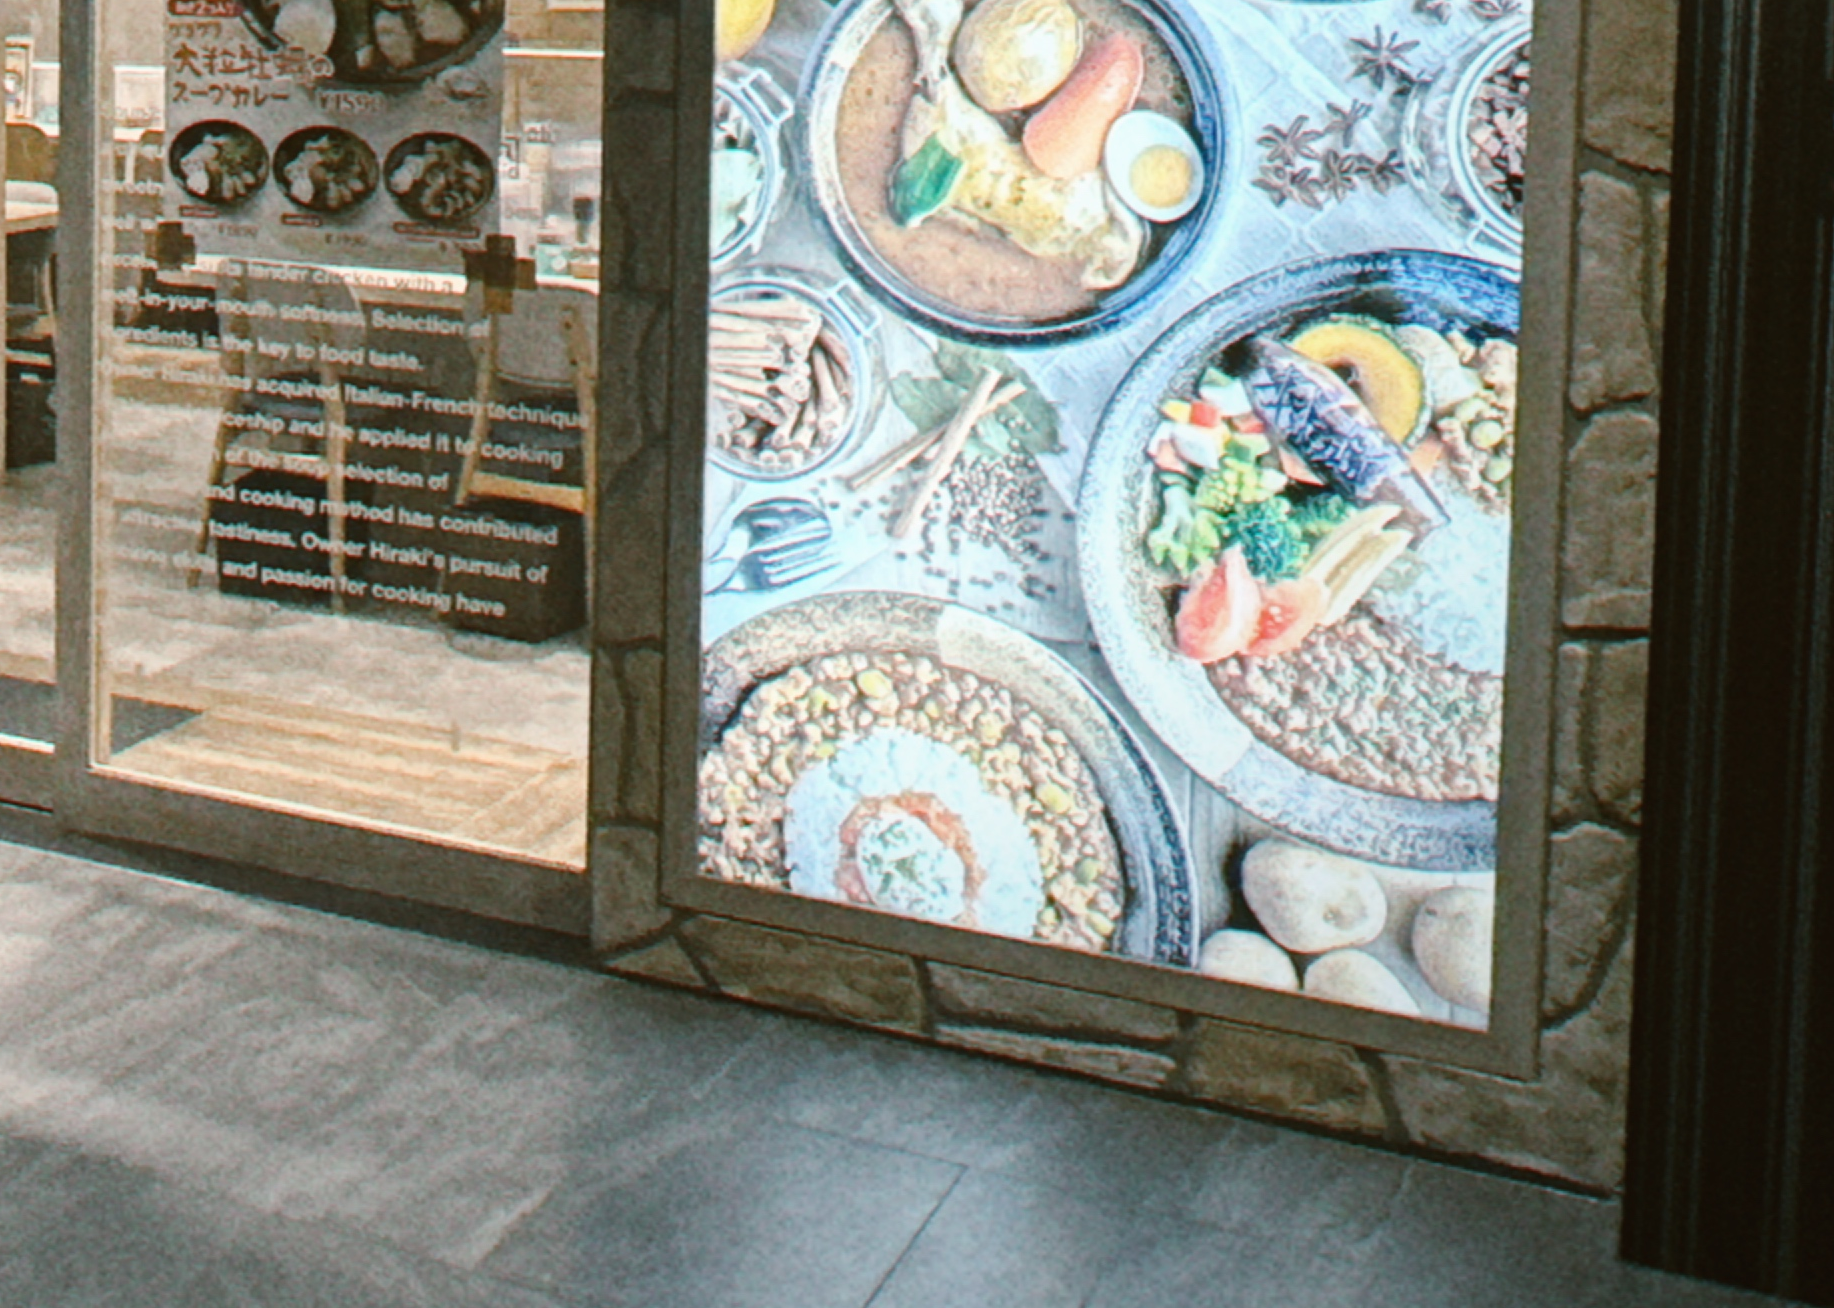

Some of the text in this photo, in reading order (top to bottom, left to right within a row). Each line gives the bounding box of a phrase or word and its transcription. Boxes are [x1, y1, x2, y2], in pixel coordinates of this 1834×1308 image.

[172, 80, 290, 109] スープカレー
[393, 273, 435, 292] with
[371, 309, 464, 336] Selection
[221, 334, 253, 354] the
[257, 337, 290, 361] key
[296, 342, 317, 360] to
[319, 342, 365, 366] food
[369, 348, 425, 373] taste.
[256, 376, 340, 402] acquired
[288, 417, 324, 438] and
[359, 427, 431, 455] applied
[436, 432, 449, 454] it
[481, 440, 564, 470] cooking
[428, 472, 449, 491] of
[239, 487, 315, 516] cooking
[399, 505, 435, 529] has
[439, 512, 559, 546] contributed
[369, 539, 445, 571] Hiraki's
[450, 554, 522, 584] pursuit
[526, 562, 550, 584] of
[222, 557, 258, 580] and
[261, 564, 336, 594] passion
[339, 574, 369, 597] for
[372, 580, 451, 613] cooking
[455, 591, 506, 619] have
